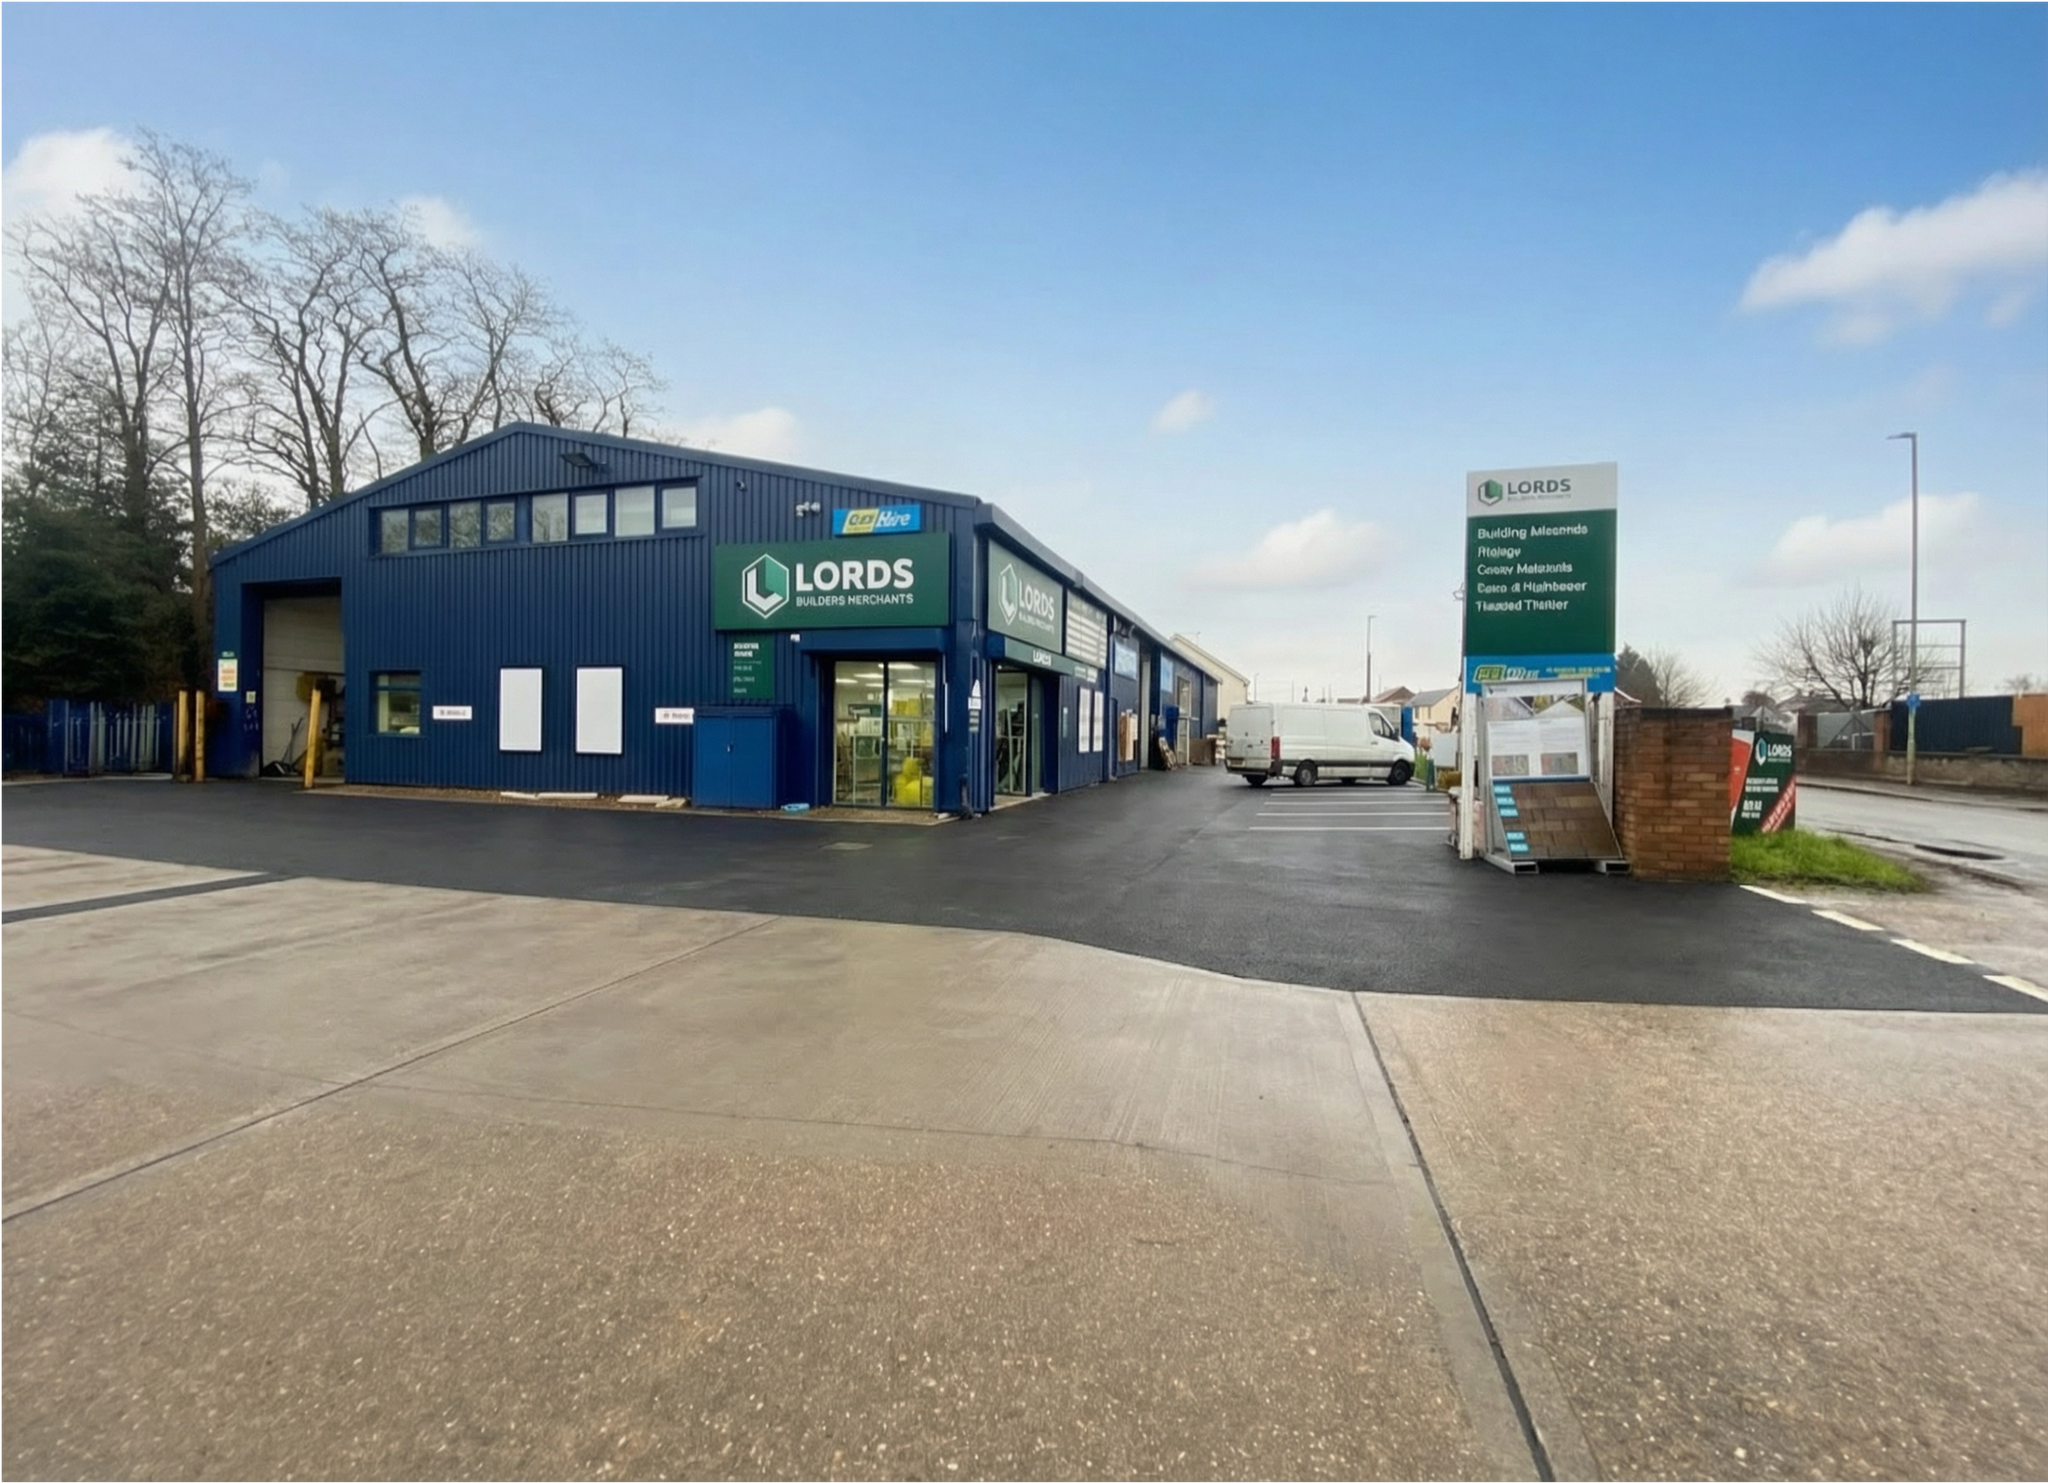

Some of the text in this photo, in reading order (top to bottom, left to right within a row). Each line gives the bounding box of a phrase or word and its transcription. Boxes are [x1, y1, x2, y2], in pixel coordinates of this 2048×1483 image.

[1507, 479, 1571, 495] LORDS
[1477, 527, 1527, 540] Building
[796, 558, 915, 592] LORDS
[796, 595, 845, 607] BUILDERS
[1019, 578, 1055, 621] LORDS
